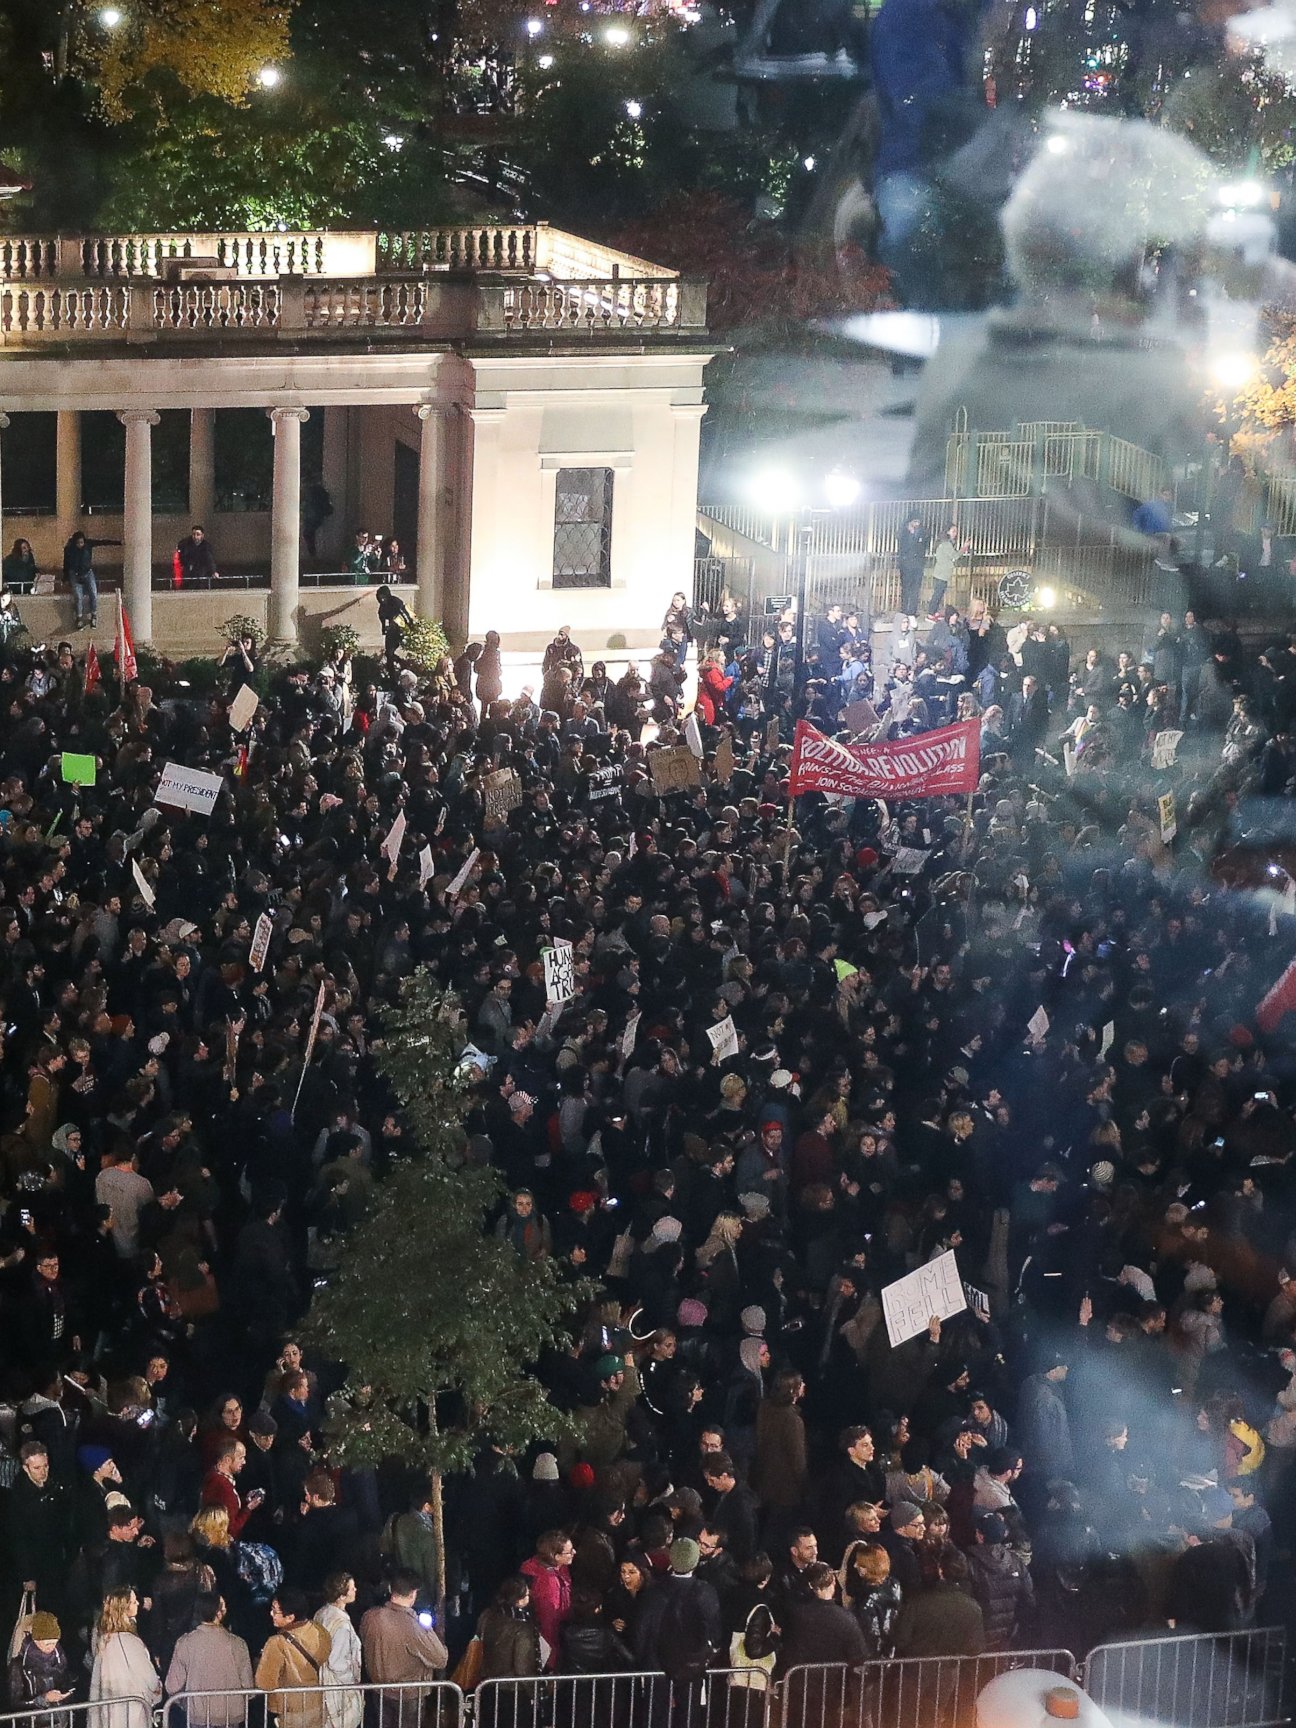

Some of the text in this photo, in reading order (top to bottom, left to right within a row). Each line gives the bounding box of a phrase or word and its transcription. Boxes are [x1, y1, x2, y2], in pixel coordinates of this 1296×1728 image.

[867, 736, 966, 780] REVOLUTION
[160, 779, 219, 801] NOT MY PRESIDENT
[816, 776, 838, 788] JOIN
[710, 1024, 725, 1041] NOT
[885, 1255, 959, 1316] ROME
[888, 1287, 963, 1344] FELL
